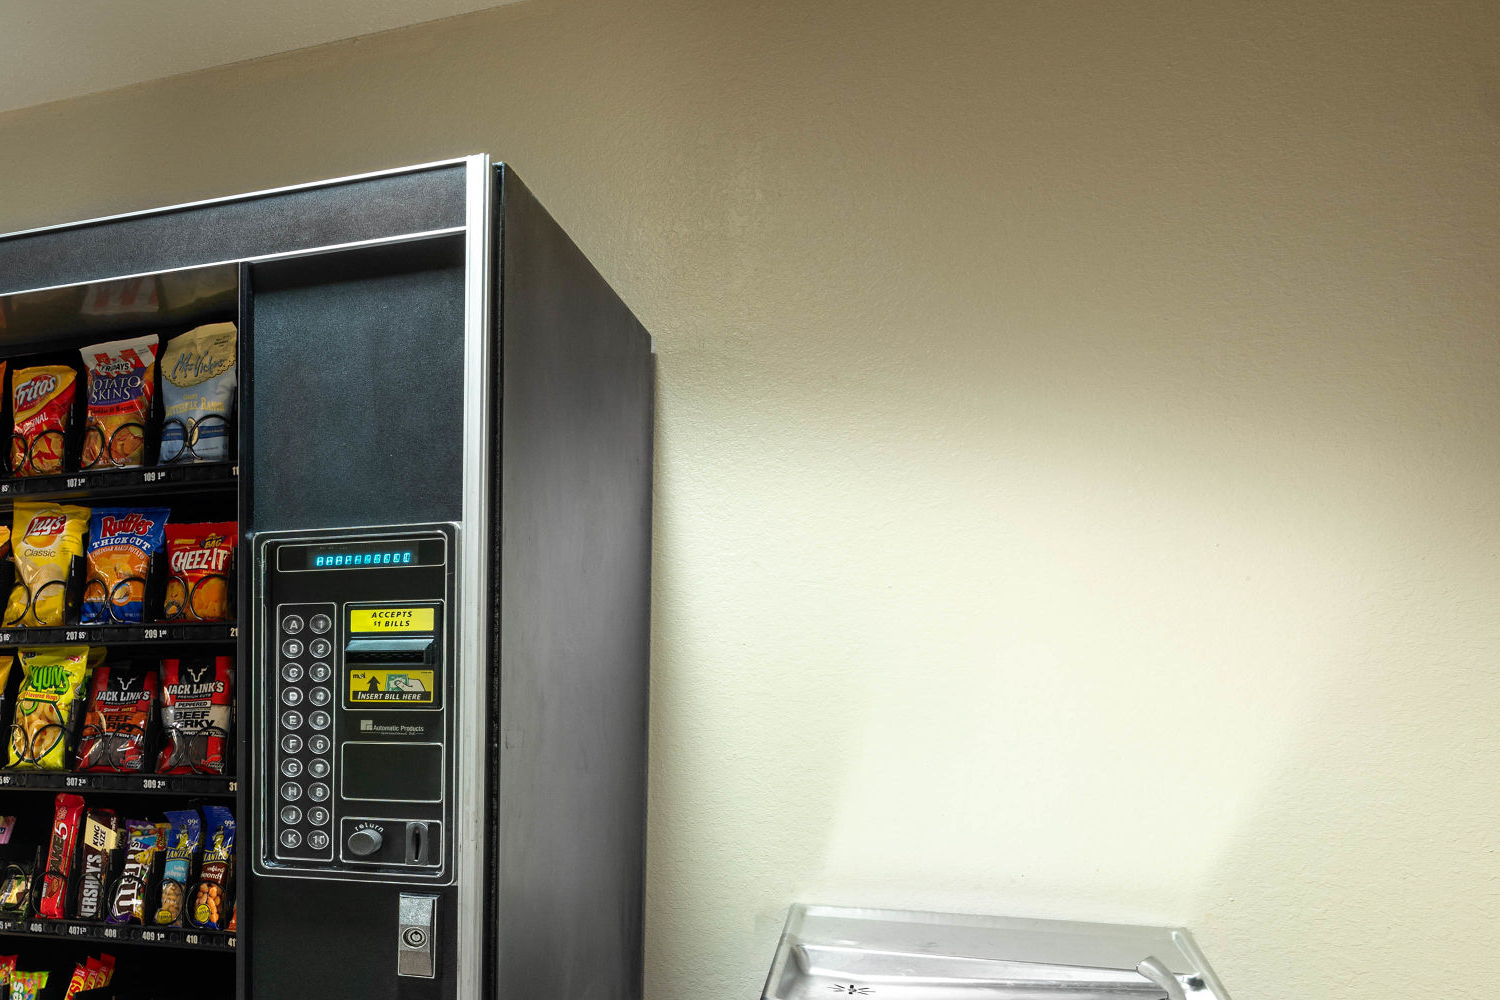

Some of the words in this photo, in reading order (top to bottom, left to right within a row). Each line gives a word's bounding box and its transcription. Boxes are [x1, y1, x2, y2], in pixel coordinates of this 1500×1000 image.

[91, 375, 142, 392] OTATO
[14, 375, 57, 410] Fritos
[91, 387, 132, 404] SKINS
[144, 472, 156, 481] 109
[67, 478, 78, 488] 107
[28, 514, 67, 537] Lay's
[101, 512, 155, 539] Ruffles
[92, 537, 129, 549] THICK
[129, 536, 152, 551] CUT
[203, 540, 222, 549] BAG
[24, 548, 57, 558] Classic
[171, 547, 228, 574] CHEEZ-IT
[371, 610, 413, 619] ACCEPTS
[289, 620, 298, 629] A
[66, 632, 78, 641] 207
[144, 629, 158, 639] 209
[289, 644, 298, 653] B
[289, 668, 298, 677] C
[168, 685, 191, 695] JACK
[193, 681, 225, 694] LINK'S
[97, 691, 117, 701] JACK
[120, 691, 151, 701] LINK'S
[289, 691, 297, 700] D
[357, 692, 382, 700] INSERT
[174, 710, 210, 720] BEEF
[289, 716, 297, 724] E
[289, 740, 297, 748] F
[288, 763, 298, 772] G
[66, 777, 78, 787] 307
[143, 779, 157, 789] 309
[288, 787, 297, 796] H
[289, 811, 295, 820] J
[54, 820, 68, 840] 5
[354, 822, 384, 833] return
[92, 824, 100, 847] KING
[99, 829, 107, 847] SIZE
[288, 835, 296, 843] K
[312, 836, 324, 845] 10
[30, 923, 43, 933] 406
[68, 925, 80, 935] 407
[104, 928, 117, 938] 408
[142, 931, 155, 941] 409
[186, 934, 198, 944] 410
